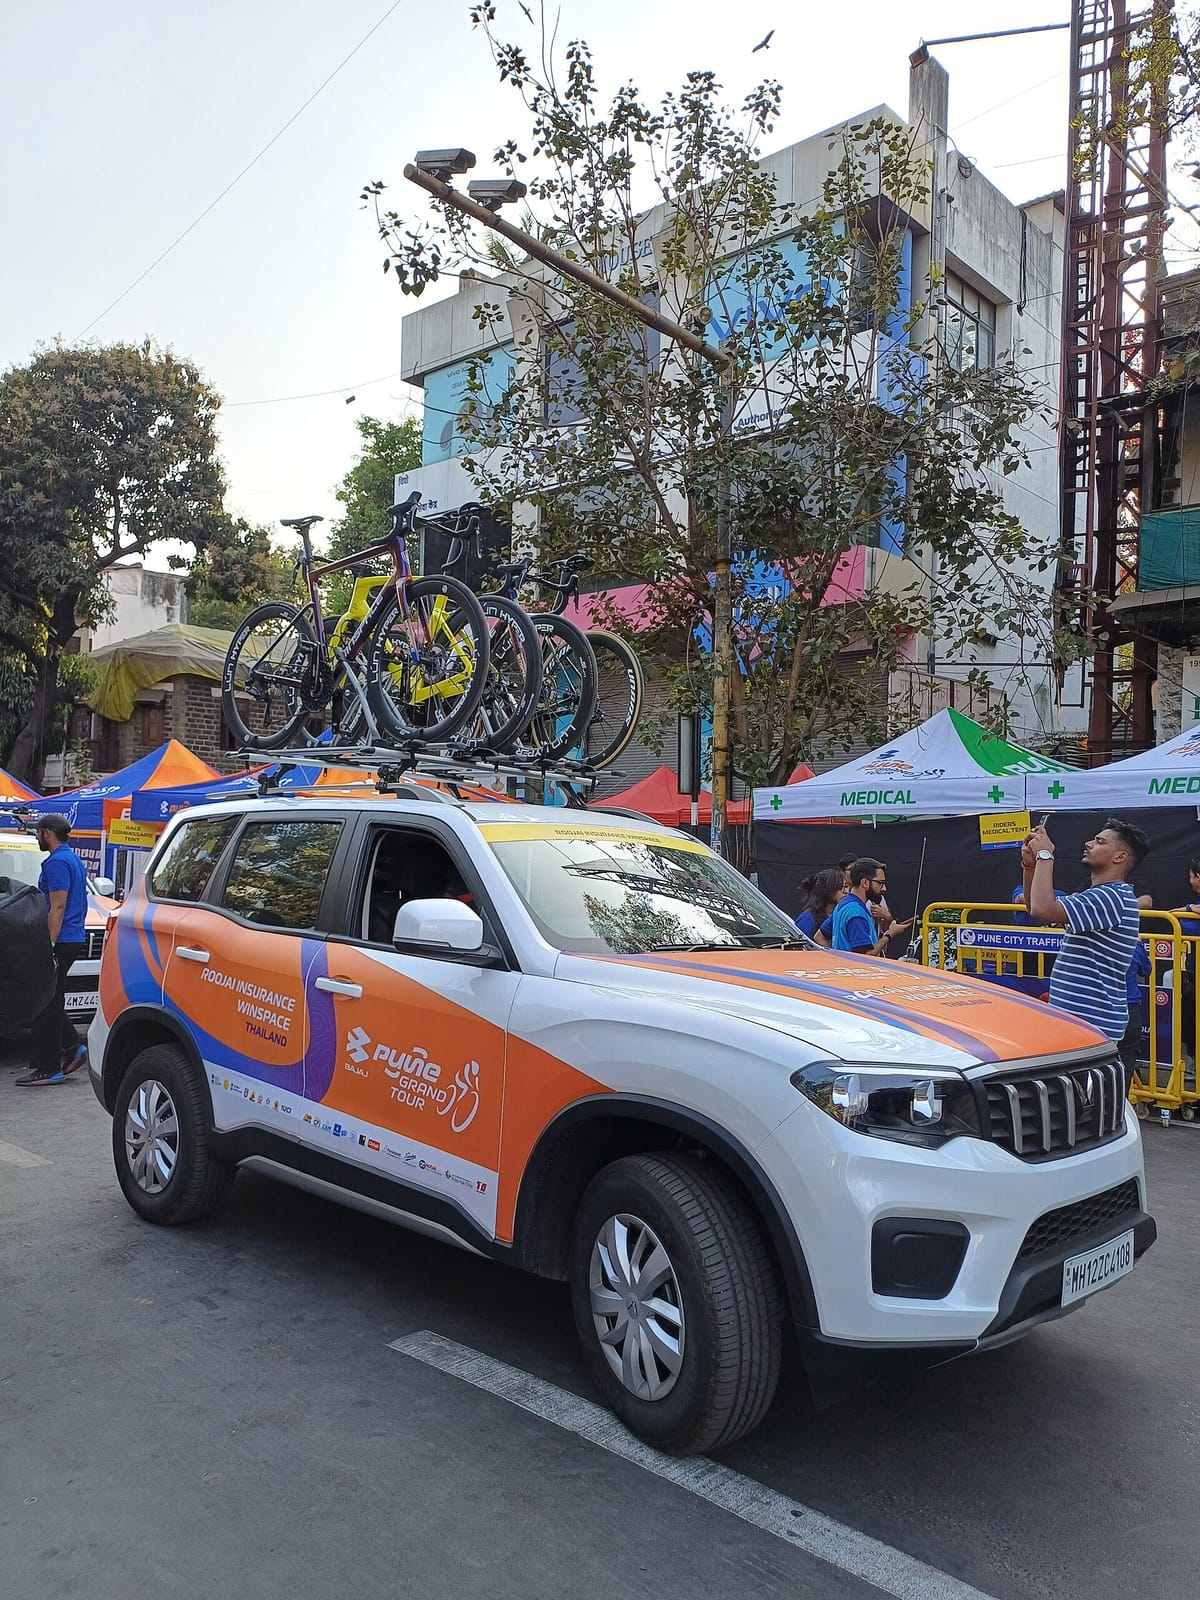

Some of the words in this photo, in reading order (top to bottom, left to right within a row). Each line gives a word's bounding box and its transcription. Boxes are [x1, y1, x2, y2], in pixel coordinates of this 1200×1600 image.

[376, 606, 400, 648] HYPER
[499, 609, 526, 643] HYPER
[840, 789, 916, 807] MEDICAL
[1148, 776, 1200, 795] MED
[977, 933, 1002, 944] PUNE
[1003, 936, 1024, 945] CITY
[201, 968, 236, 990] ROOJAI
[236, 979, 296, 1012] INSURANCE
[237, 999, 291, 1031] WINSPACE
[246, 1021, 287, 1047] THAILAND
[344, 1062, 369, 1078] BAJAJ
[390, 1086, 425, 1111] TOUR
[399, 1076, 447, 1103] GRAND
[1071, 1240, 1131, 1294] MH12ZC4108
